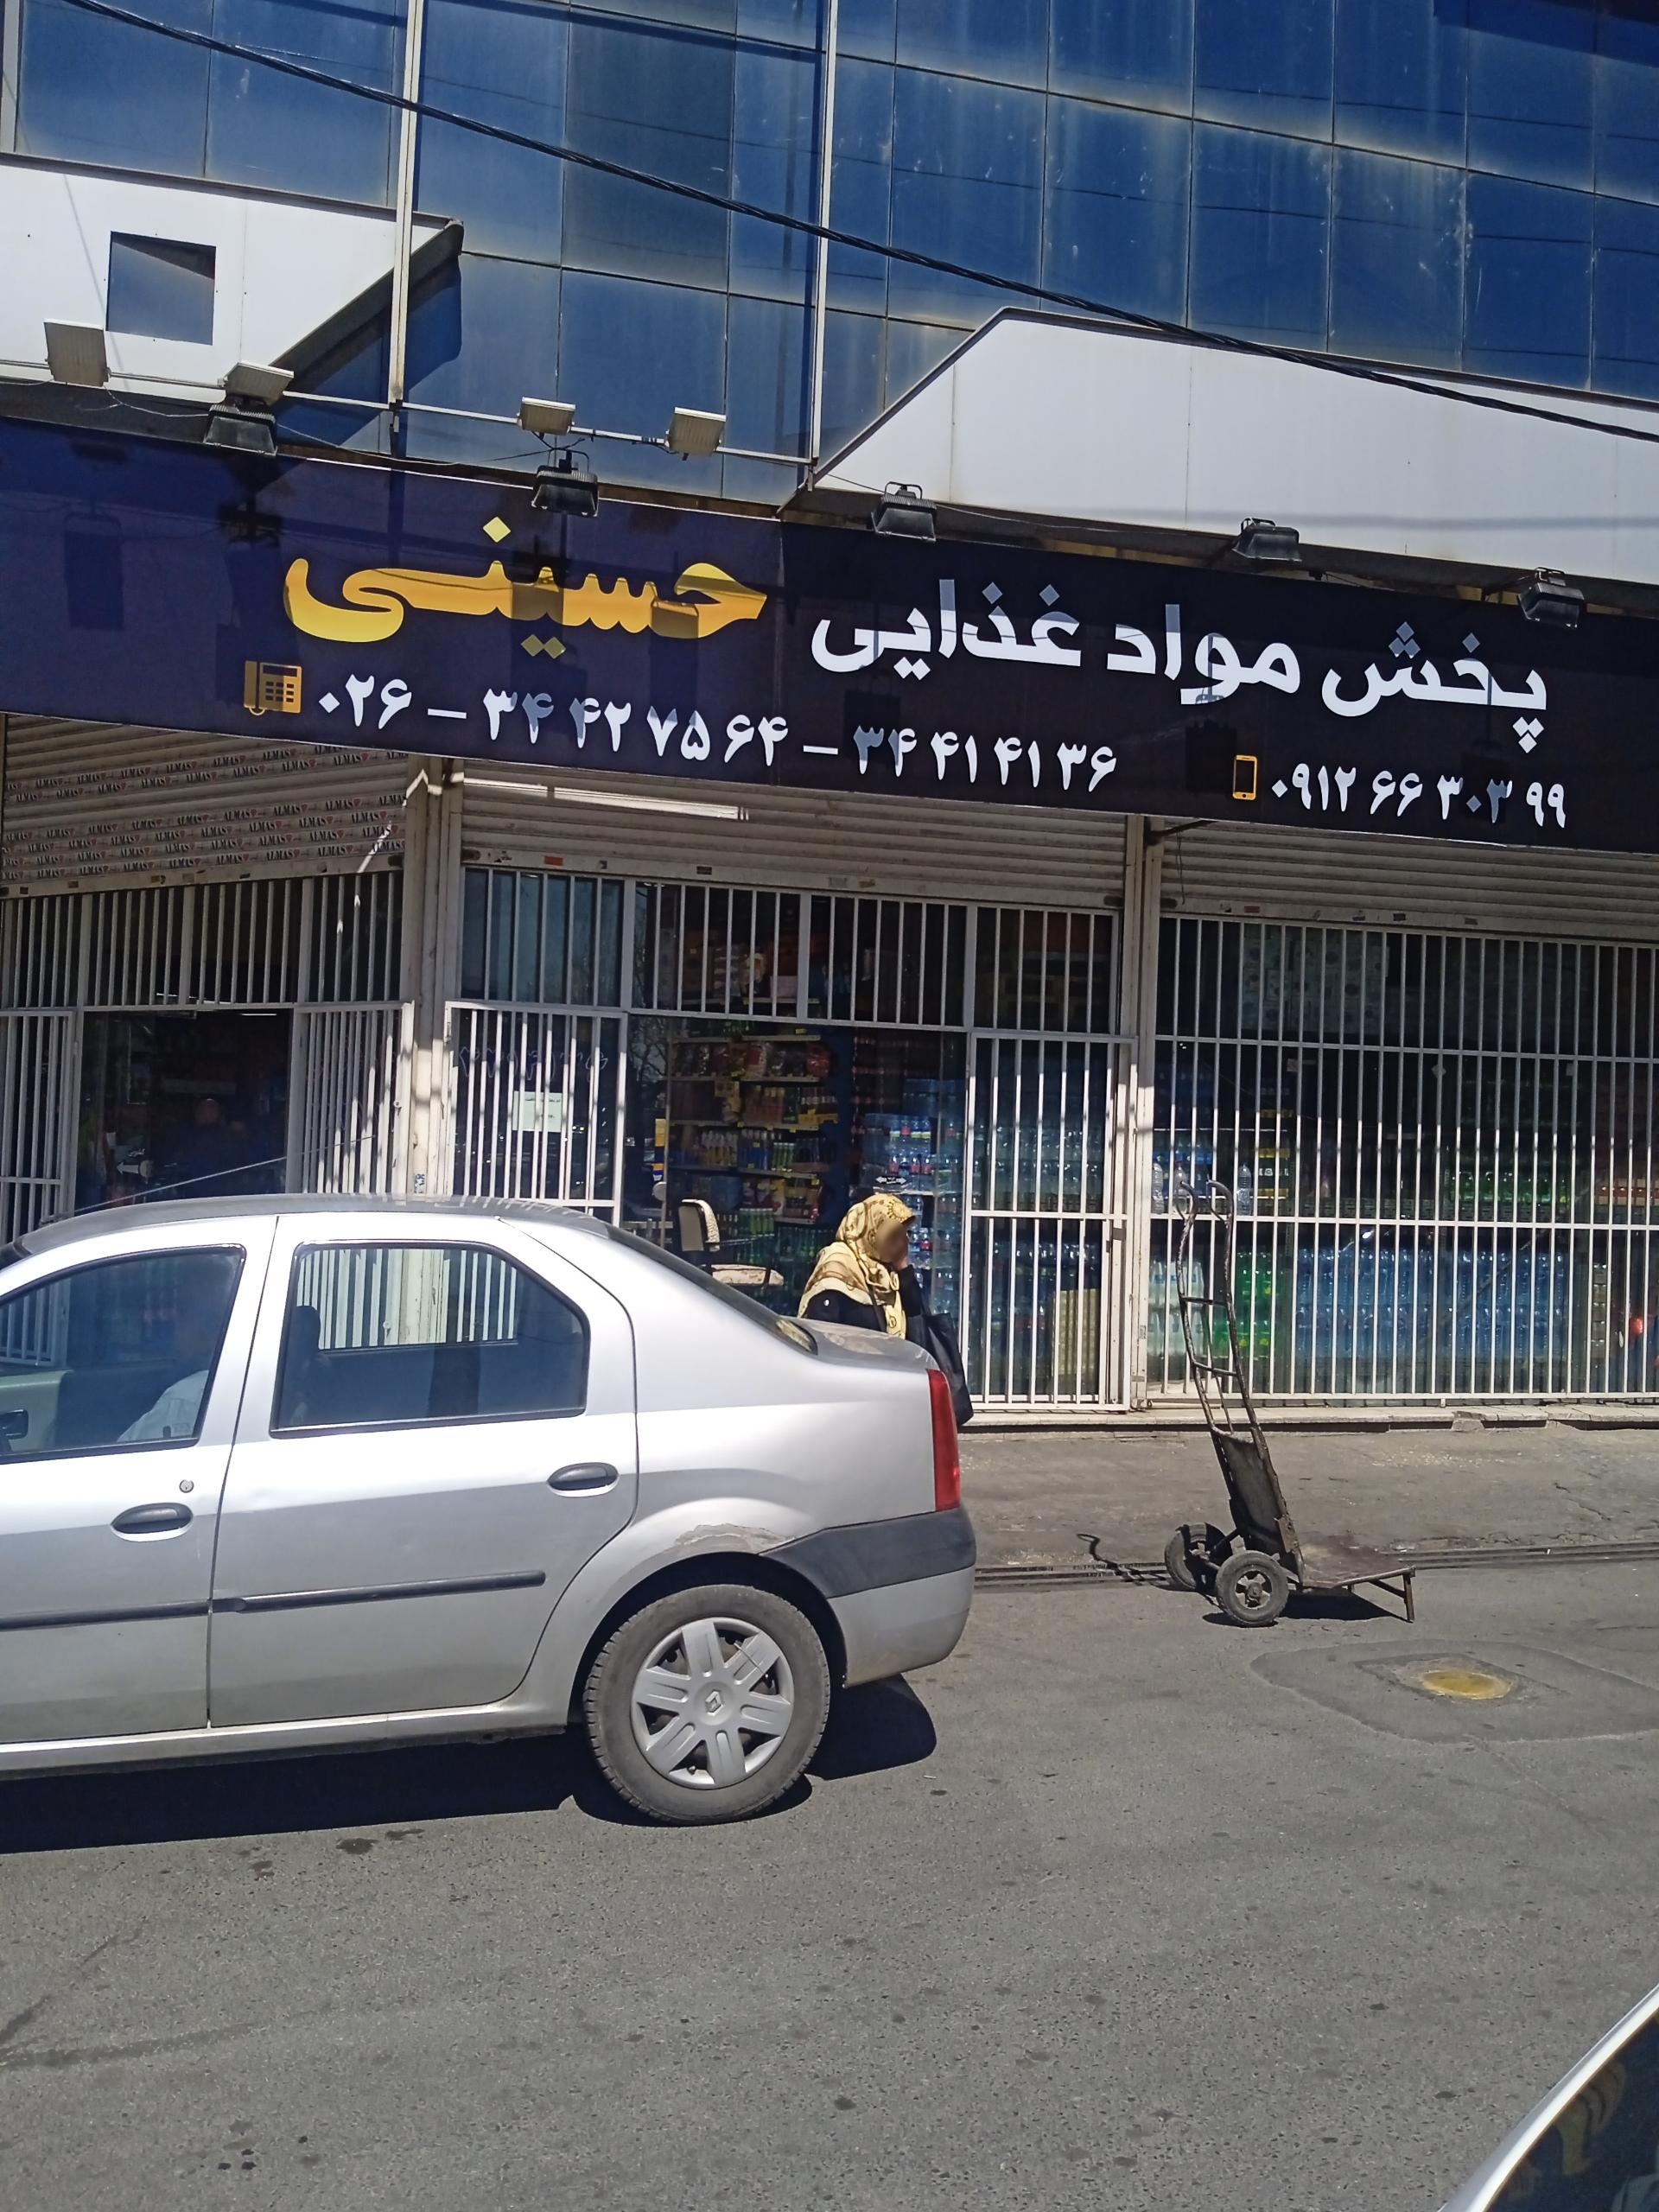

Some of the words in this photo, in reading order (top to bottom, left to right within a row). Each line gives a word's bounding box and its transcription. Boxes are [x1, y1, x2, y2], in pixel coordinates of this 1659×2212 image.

[283, 516, 768, 659] حسینی
[810, 579, 1082, 681] غذایی
[1106, 604, 1301, 705] مواد
[1321, 621, 1547, 753] پخش
[318, 673, 412, 730] ۰۲۶
[646, 705, 711, 761] ۷۵
[142, 778, 165, 788] ALMAS
[187, 772, 211, 783] ALMAS
[233, 766, 259, 778] ALMAS
[282, 760, 309, 772] ALMAS
[334, 753, 361, 766] ALMAS
[166, 762, 191, 772] ALMAS
[213, 756, 239, 767] ALMAS
[263, 749, 290, 760] ALMAS
[132, 819, 156, 830] ALMAS
[178, 815, 202, 825] ALMAS
[225, 810, 251, 821] ALMAS
[273, 805, 301, 816] ALMAS
[325, 799, 353, 810] ALMAS
[1271, 763, 1357, 812] ۰۹۱۲
[1370, 770, 1423, 817] ۶۶
[1525, 781, 1567, 829] ۹۹
[156, 830, 180, 842] ALMAS
[201, 826, 226, 836] ALMAS
[249, 821, 276, 833] ALMAS
[299, 817, 327, 828] ALMAS
[351, 811, 380, 823] ALMAS
[166, 843, 190, 854] ALMAS
[211, 839, 237, 850] ALMAS
[259, 835, 286, 846] ALMAS
[309, 830, 337, 842] ALMAS
[362, 825, 391, 837] ALMAS
[169, 858, 194, 869] ALMAS
[216, 854, 242, 865] ALMAS
[266, 850, 294, 861] ALMAS
[318, 845, 346, 857] ALMAS
[372, 841, 401, 852] ALMAS
